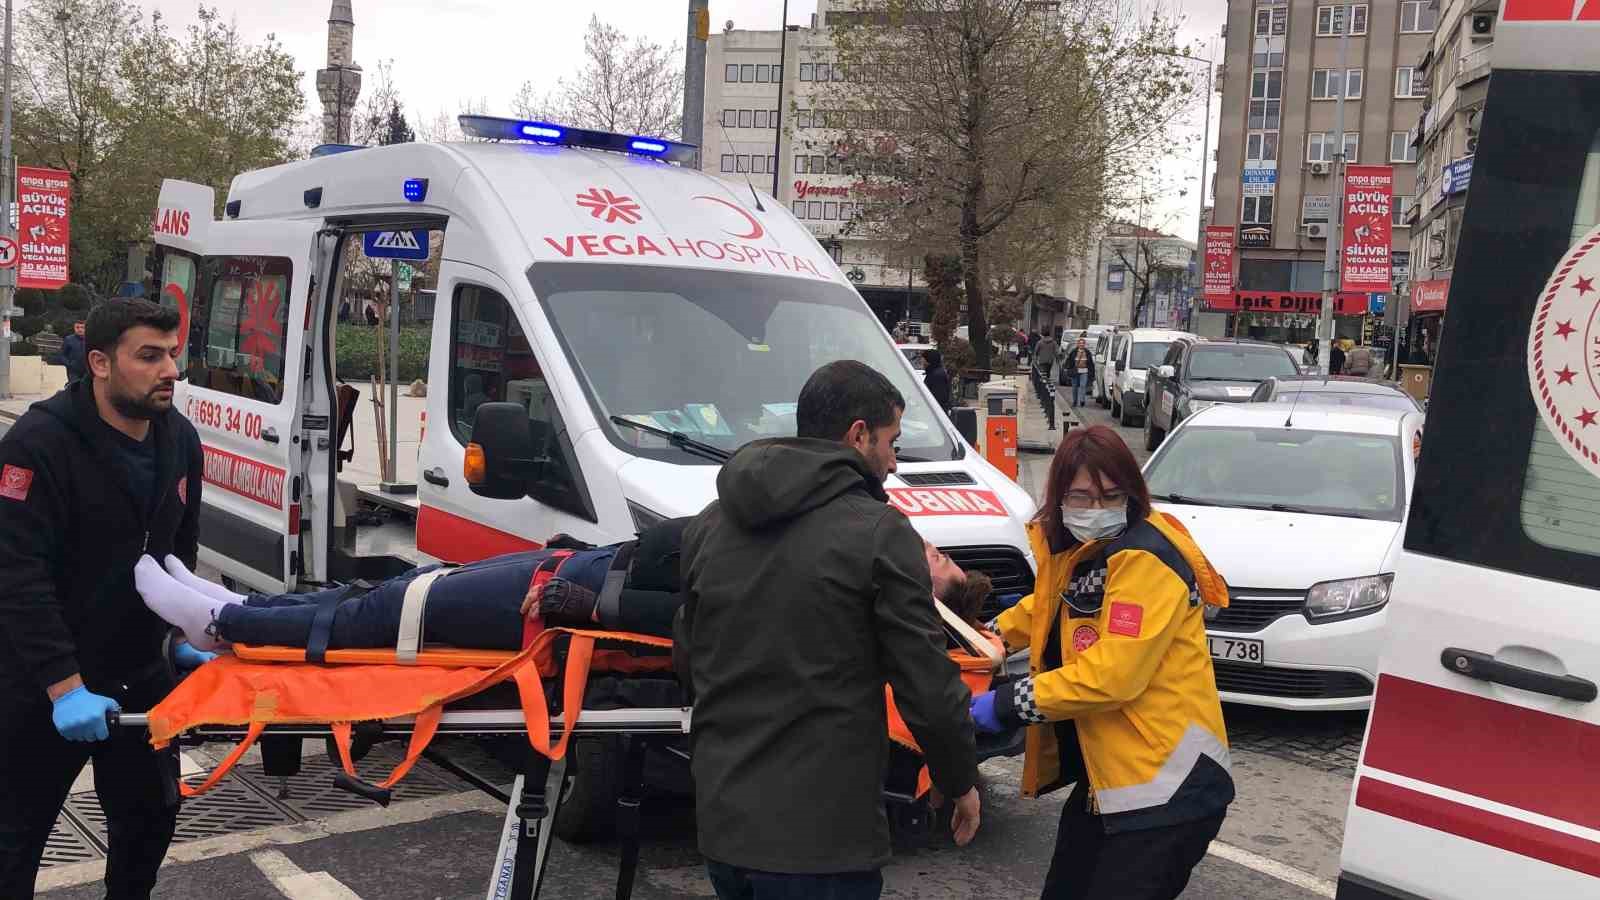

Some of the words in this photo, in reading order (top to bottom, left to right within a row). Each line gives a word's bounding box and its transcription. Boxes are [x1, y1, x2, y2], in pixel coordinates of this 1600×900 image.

[22, 192, 66, 206] BÜYÜK
[1348, 191, 1390, 203] BÜYÜK
[22, 204, 66, 219] AÇILIŞ
[1349, 203, 1389, 216] AÇILIŞ
[22, 241, 66, 255] SİLİVRİ
[1346, 243, 1388, 256] SİLİVRİ
[544, 234, 665, 257] VEGA
[667, 237, 832, 280] HOSPITAL
[200, 400, 222, 428] 693
[225, 407, 241, 433] 34
[244, 412, 262, 440] 00
[203, 449, 233, 486] YARDIM
[232, 459, 284, 507] AMBULANSI
[1224, 640, 1260, 661] 738
